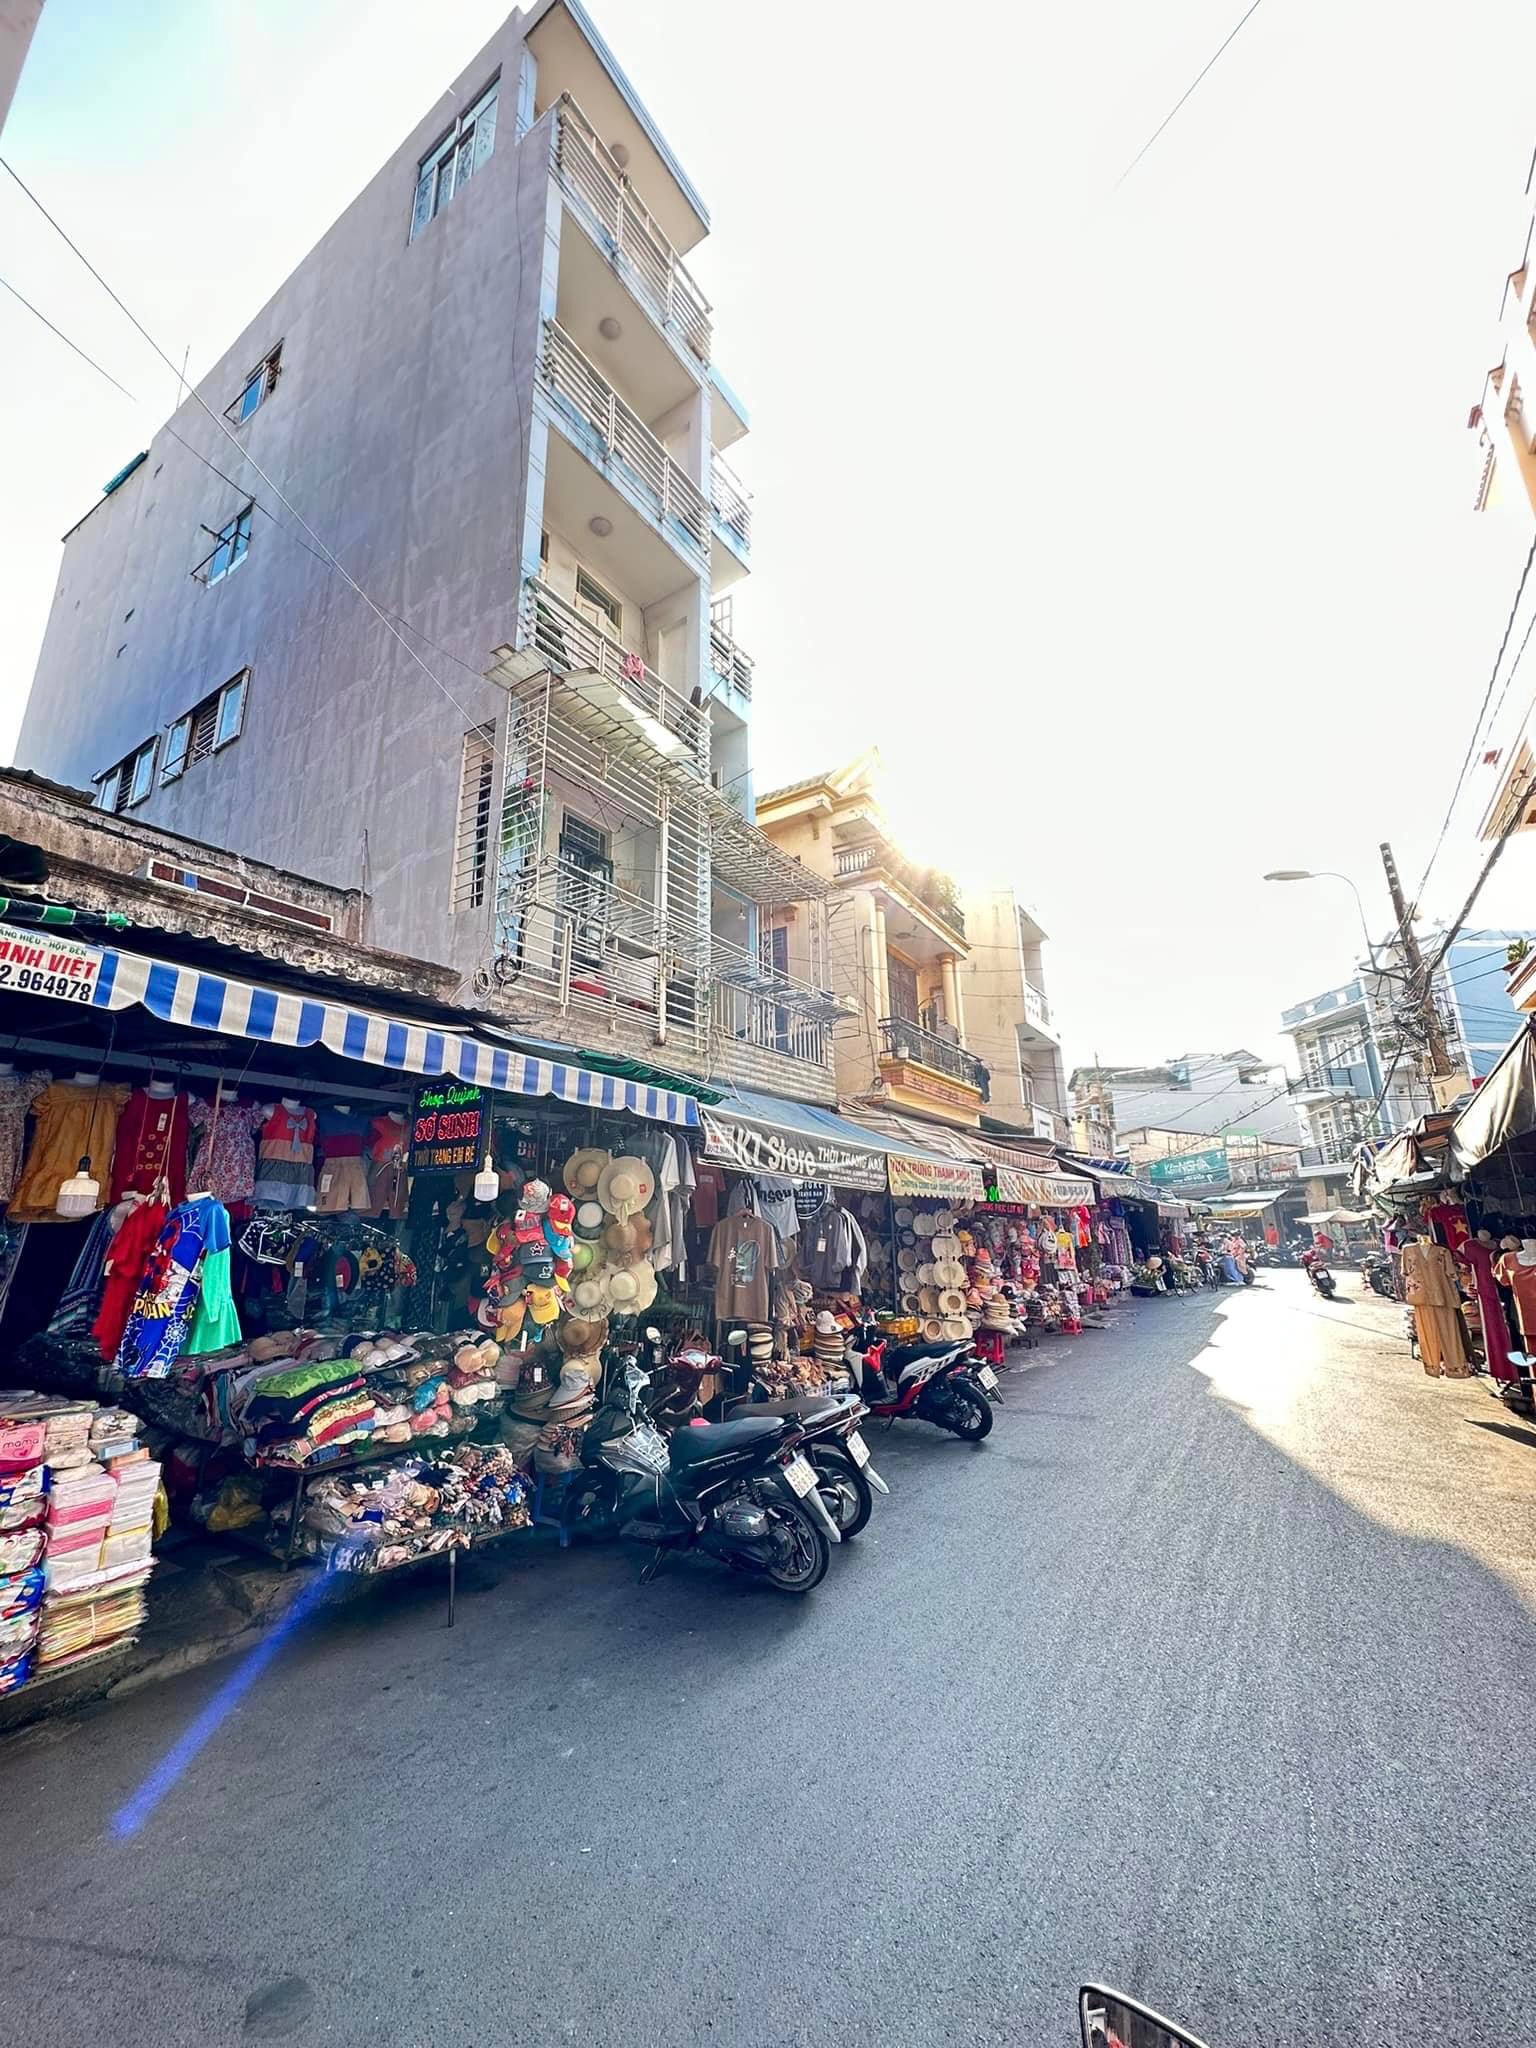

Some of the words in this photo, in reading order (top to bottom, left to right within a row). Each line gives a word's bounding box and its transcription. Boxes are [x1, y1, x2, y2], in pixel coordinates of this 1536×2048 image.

[419, 1089, 444, 1108] Shop
[438, 1111, 480, 1140] SINH
[768, 1135, 817, 1176] Store
[3, 1438, 39, 1449] mama
